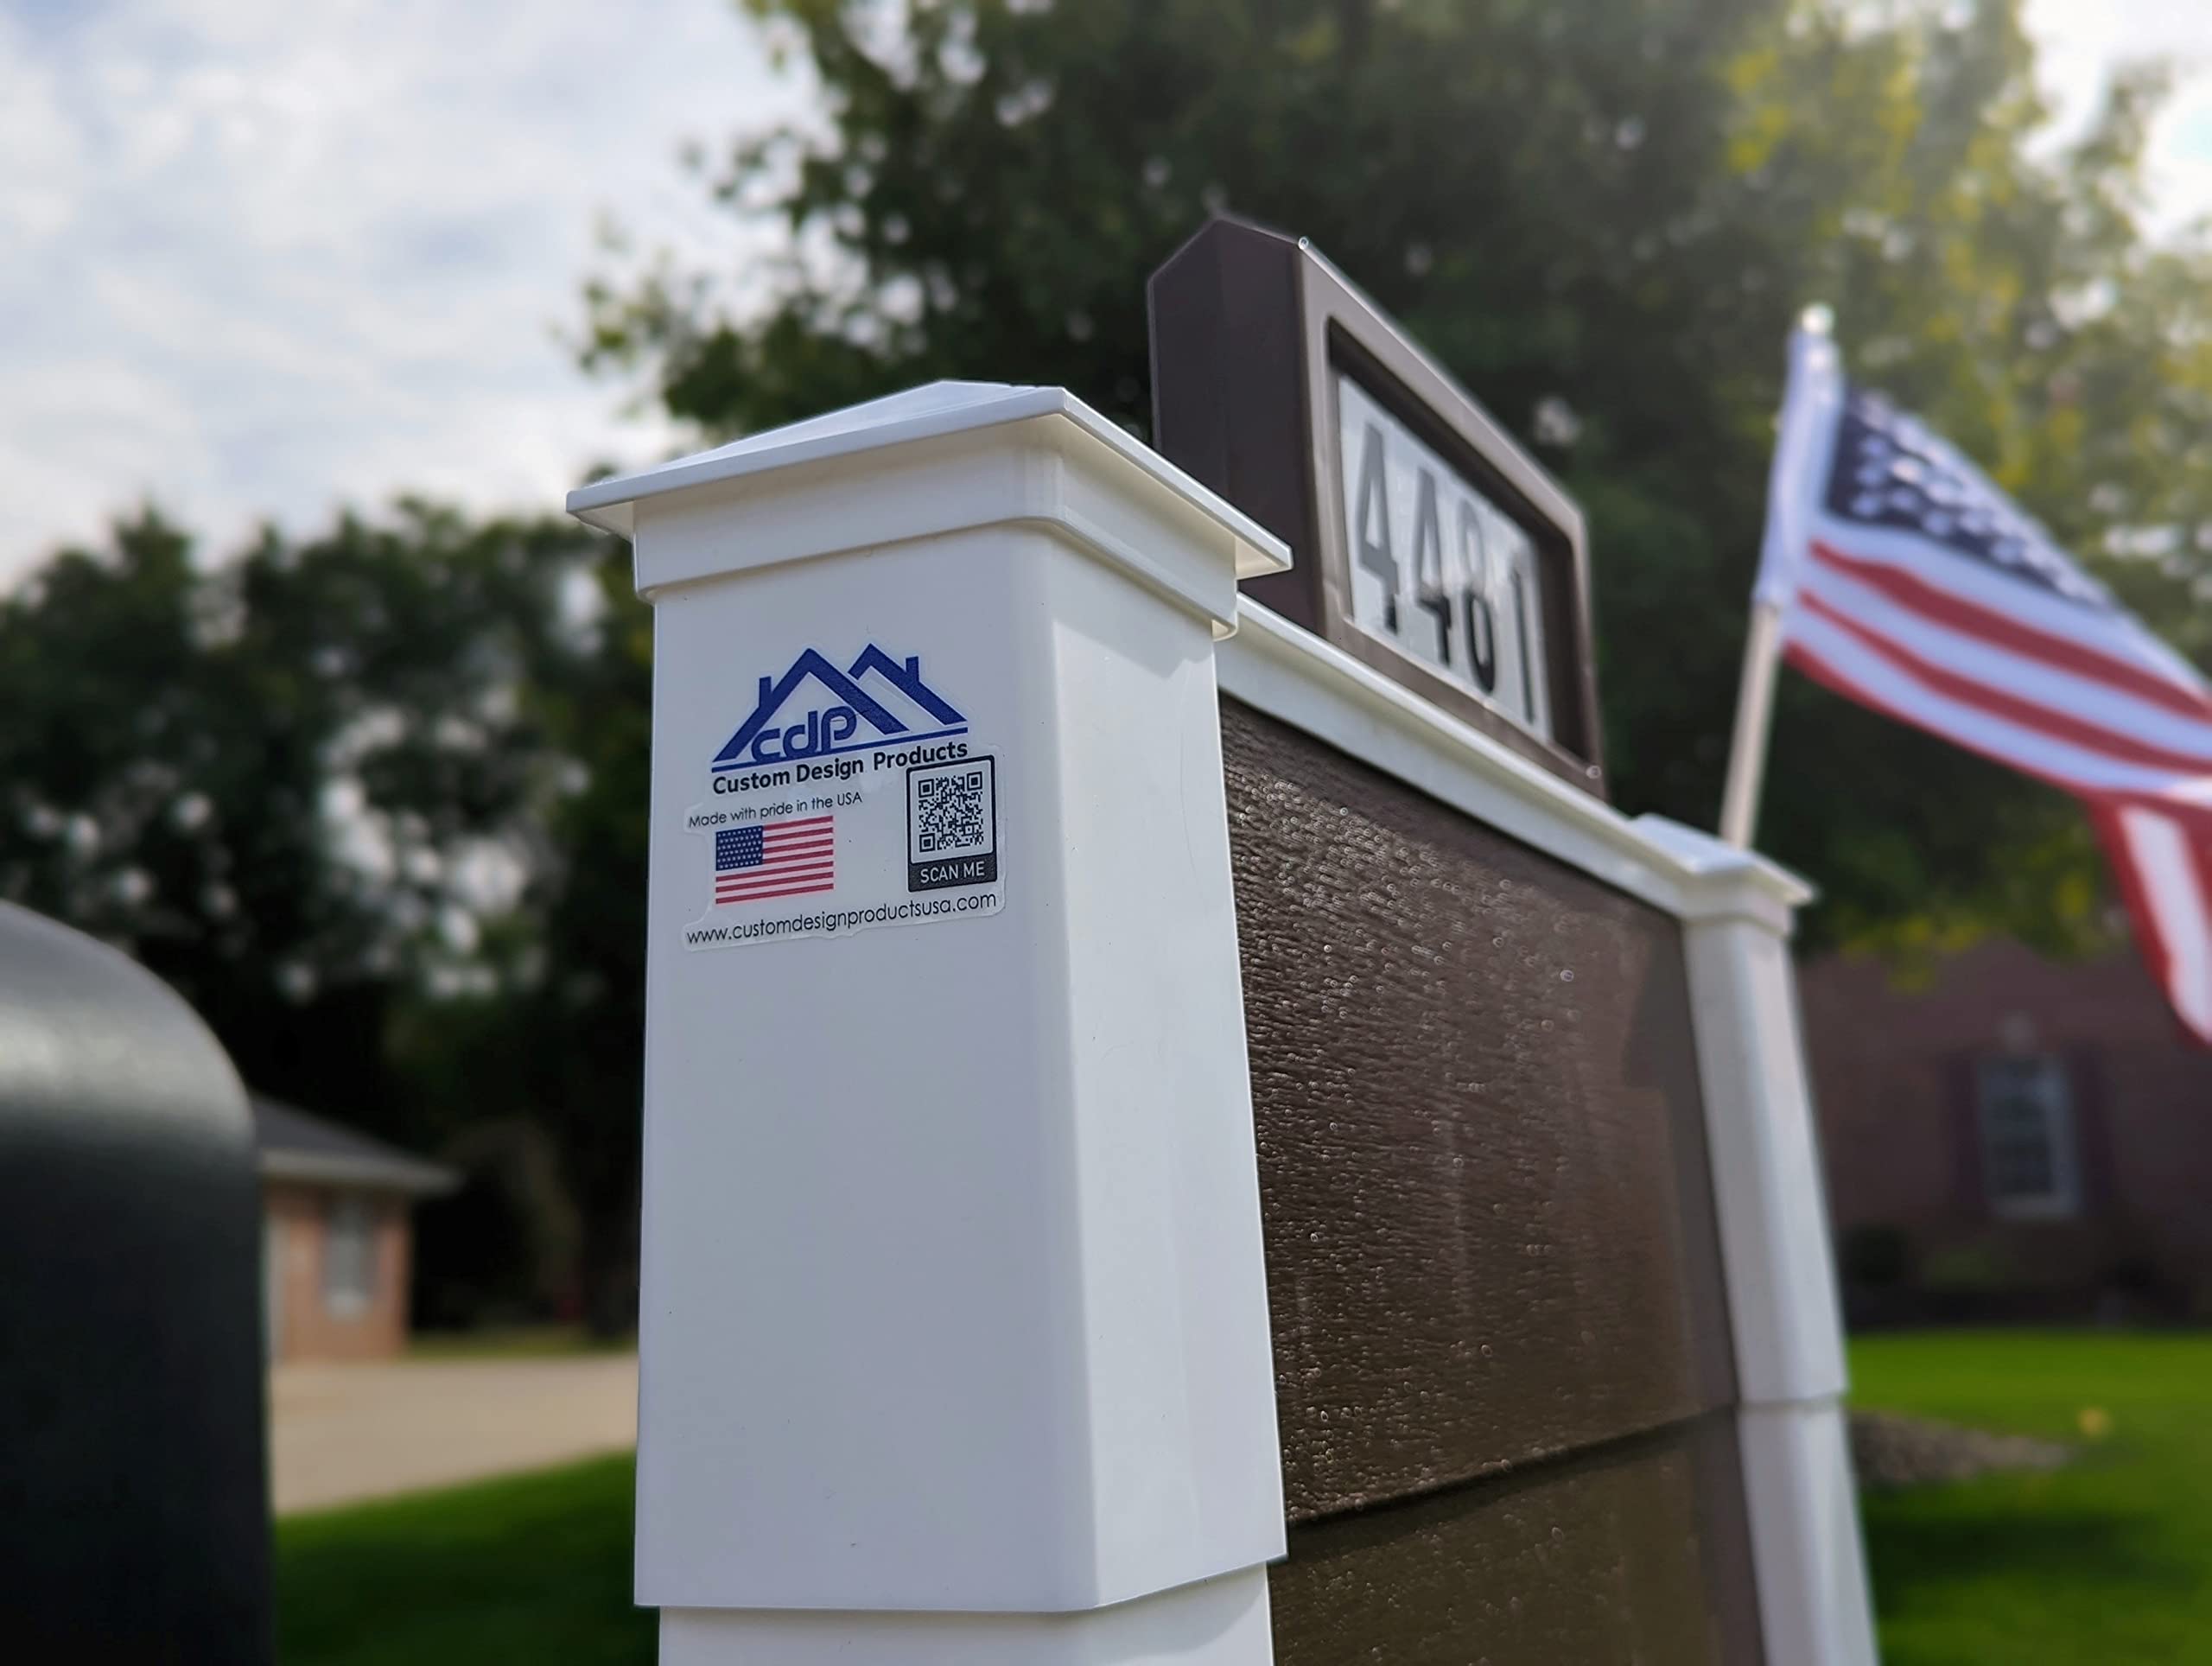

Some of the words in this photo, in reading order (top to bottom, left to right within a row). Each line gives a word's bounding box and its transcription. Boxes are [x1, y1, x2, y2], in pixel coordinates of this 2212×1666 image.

[713, 771, 790, 794] Custom
[797, 758, 863, 781] Design
[874, 741, 968, 771] Products
[689, 811, 727, 828] Made
[731, 805, 756, 821] with
[760, 801, 793, 819] pride
[797, 798, 807, 812] in
[811, 795, 833, 810] the
[837, 792, 861, 805] USA
[920, 865, 958, 883] SCAN
[963, 862, 985, 876] ME
[688, 893, 996, 944] www.customdesignproductsusa.com
